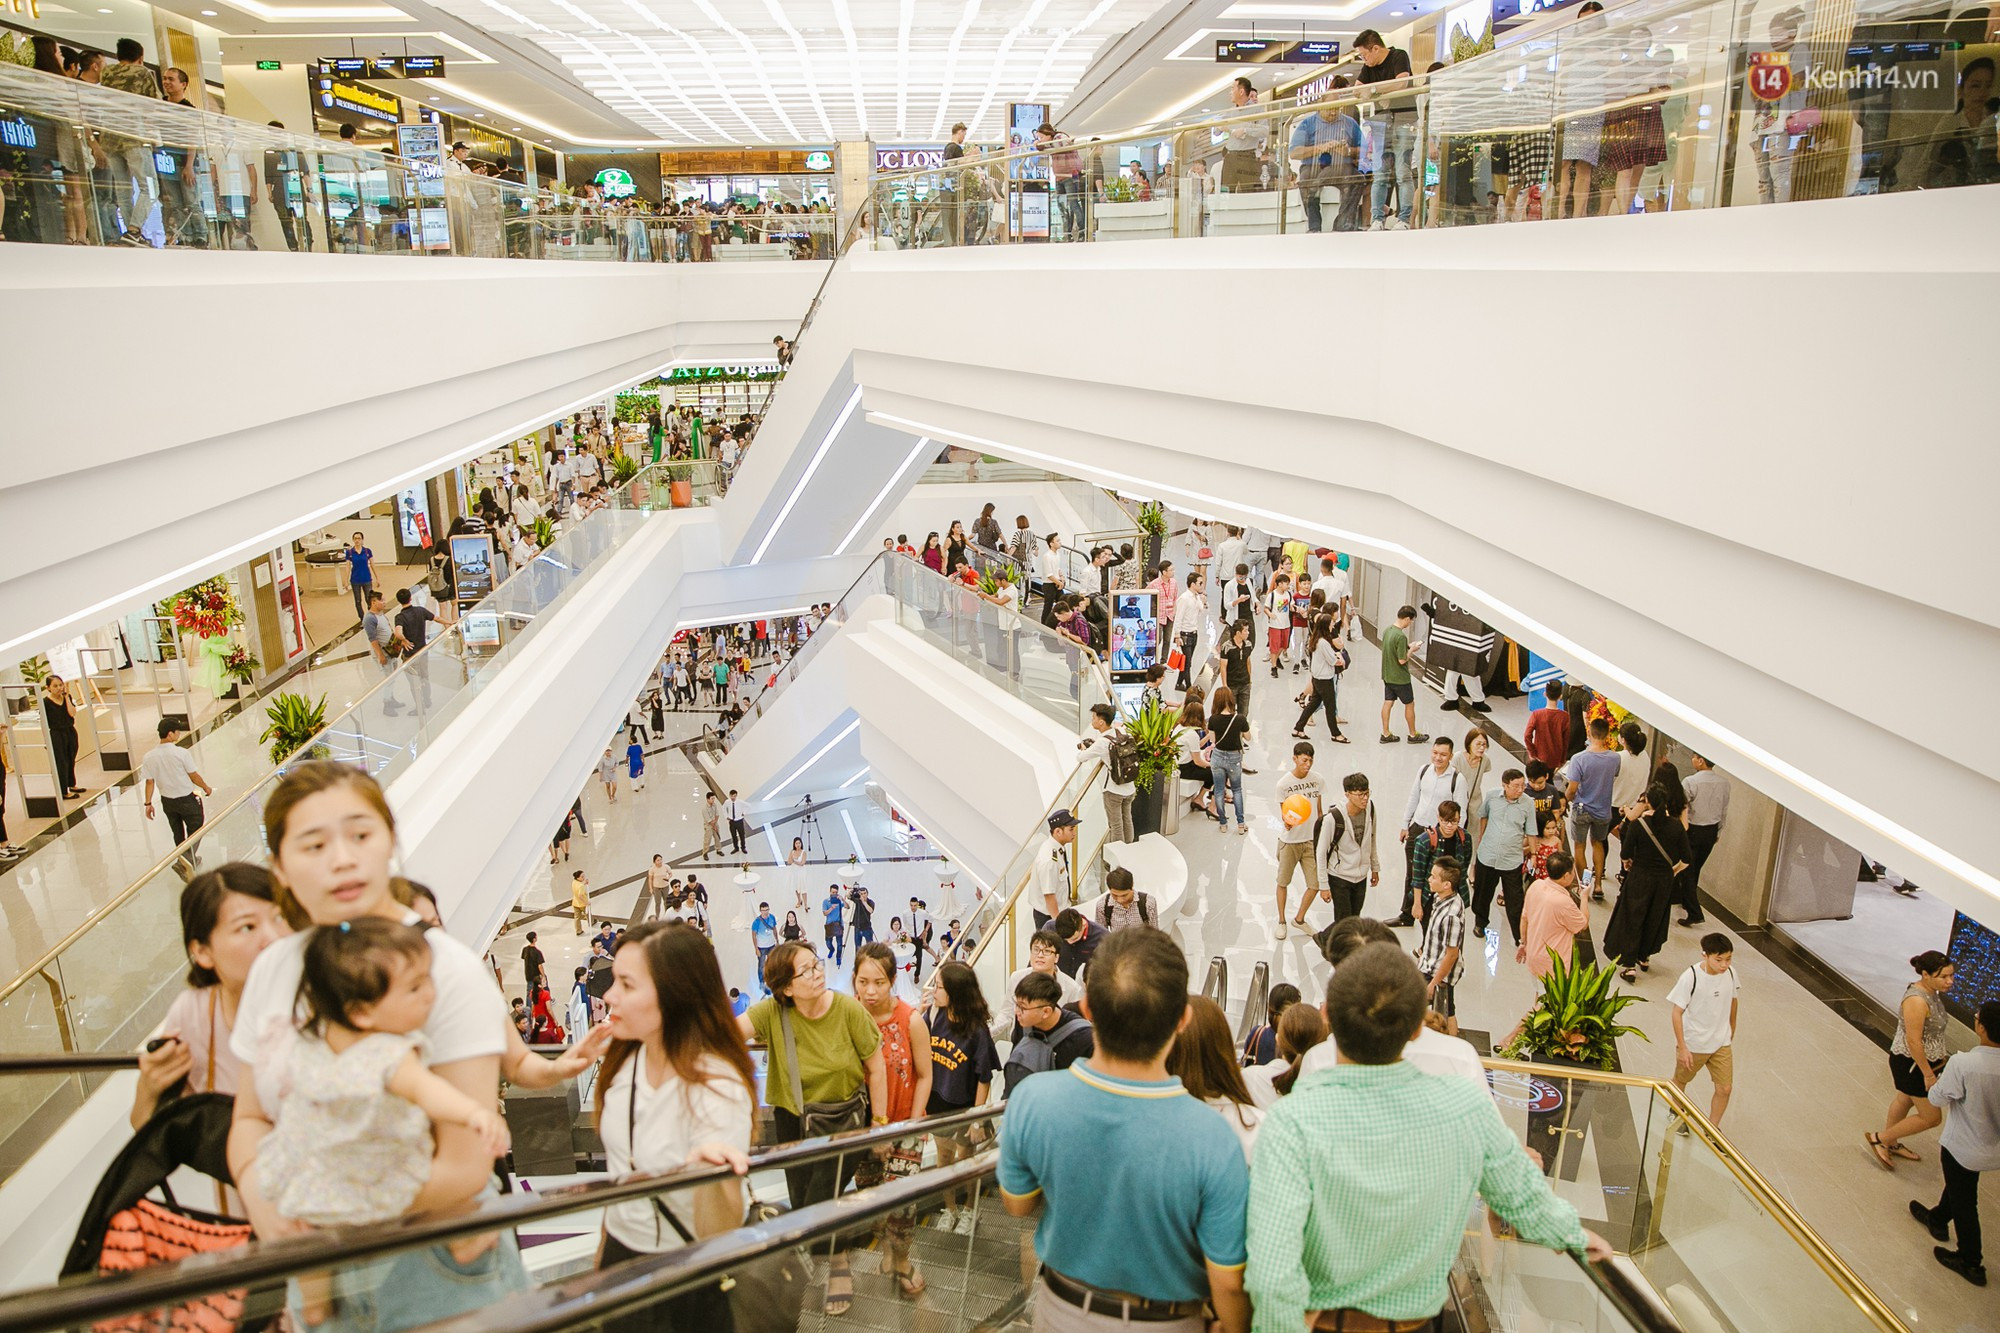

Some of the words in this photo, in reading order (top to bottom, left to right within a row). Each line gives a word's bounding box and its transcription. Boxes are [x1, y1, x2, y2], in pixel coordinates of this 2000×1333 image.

[876, 152, 899, 169] UC
[900, 152, 945, 169] LON
[930, 1035, 956, 1053] EAT
[952, 1048, 968, 1064] IT
